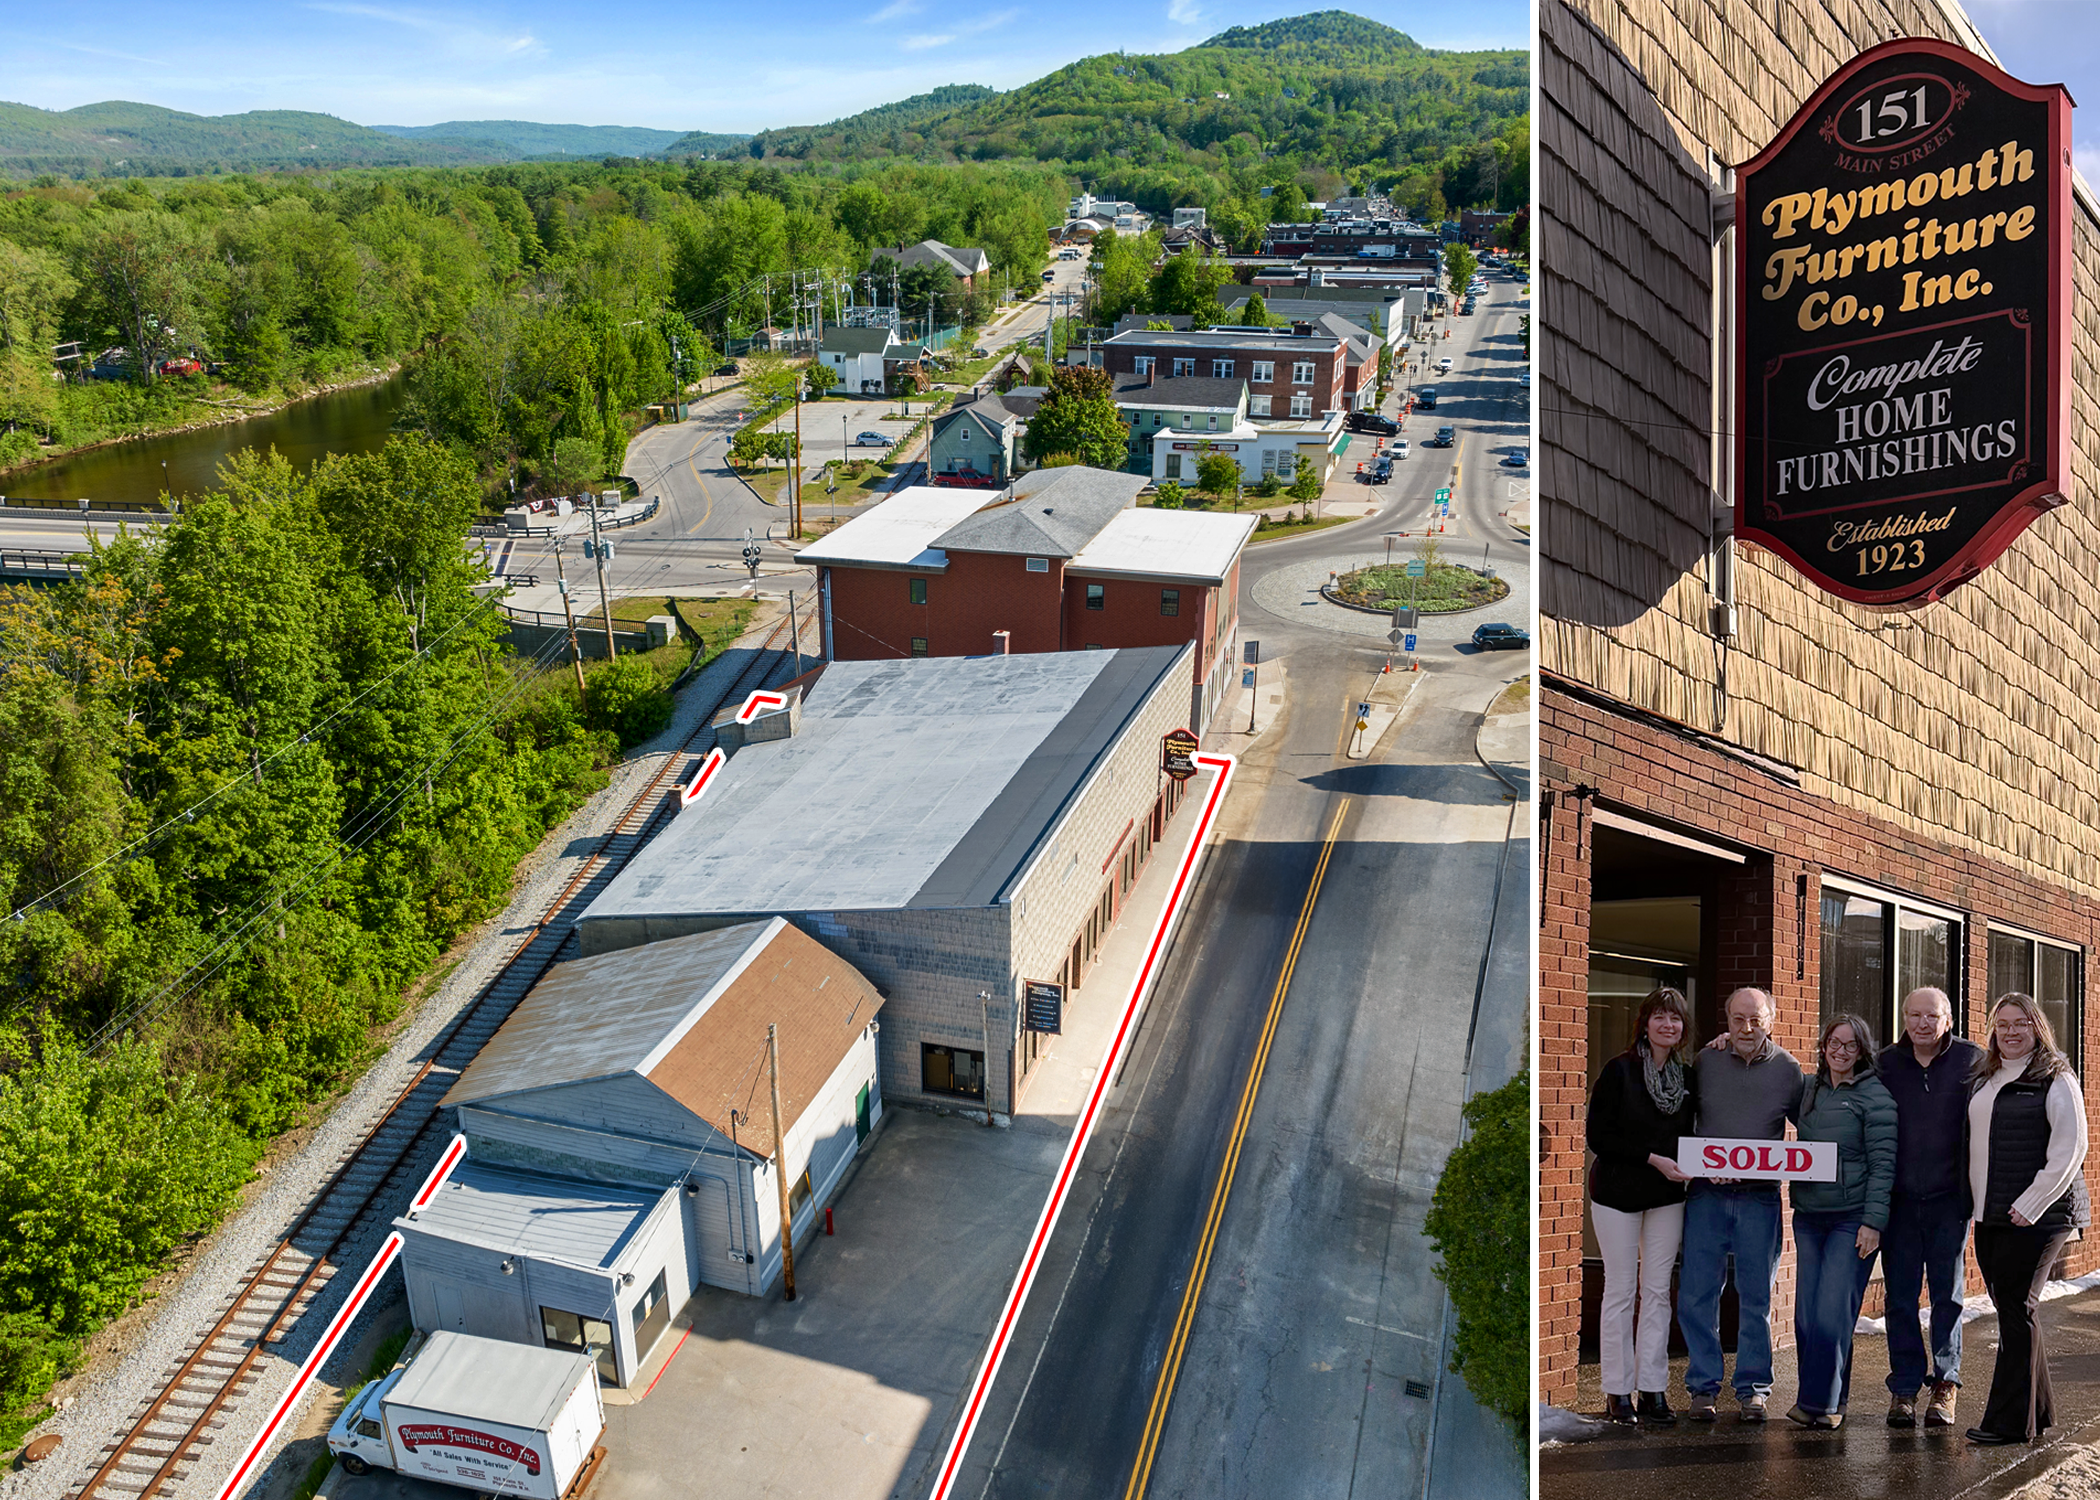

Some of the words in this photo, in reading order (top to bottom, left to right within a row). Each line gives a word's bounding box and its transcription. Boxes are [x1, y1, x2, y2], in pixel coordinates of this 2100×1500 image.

[1855, 85, 1931, 144] 151
[1834, 152, 1884, 173] MAIN
[1889, 124, 1956, 170] STREET
[1761, 140, 2035, 240] Plymouth
[1761, 205, 2036, 301] Furniture
[1797, 290, 1884, 331] Co.,
[1899, 268, 1993, 312] Inc.
[1807, 335, 1984, 412] Complete
[1835, 387, 1952, 444] HOME
[1776, 418, 2017, 496] FURNISHINGS
[1826, 506, 1957, 552] Established
[1855, 539, 1925, 577] 1923
[1407, 636, 1414, 644] H
[1166, 738, 1196, 746] Plymouth
[1702, 1145, 1813, 1173] SOLD
[402, 1427, 444, 1444] Plymouth
[448, 1429, 495, 1450] Furniture
[498, 1442, 515, 1456] Co.
[430, 1449, 442, 1457] "All
[444, 1452, 462, 1461] Sales
[464, 1456, 481, 1464] With
[483, 1459, 512, 1470] Service"
